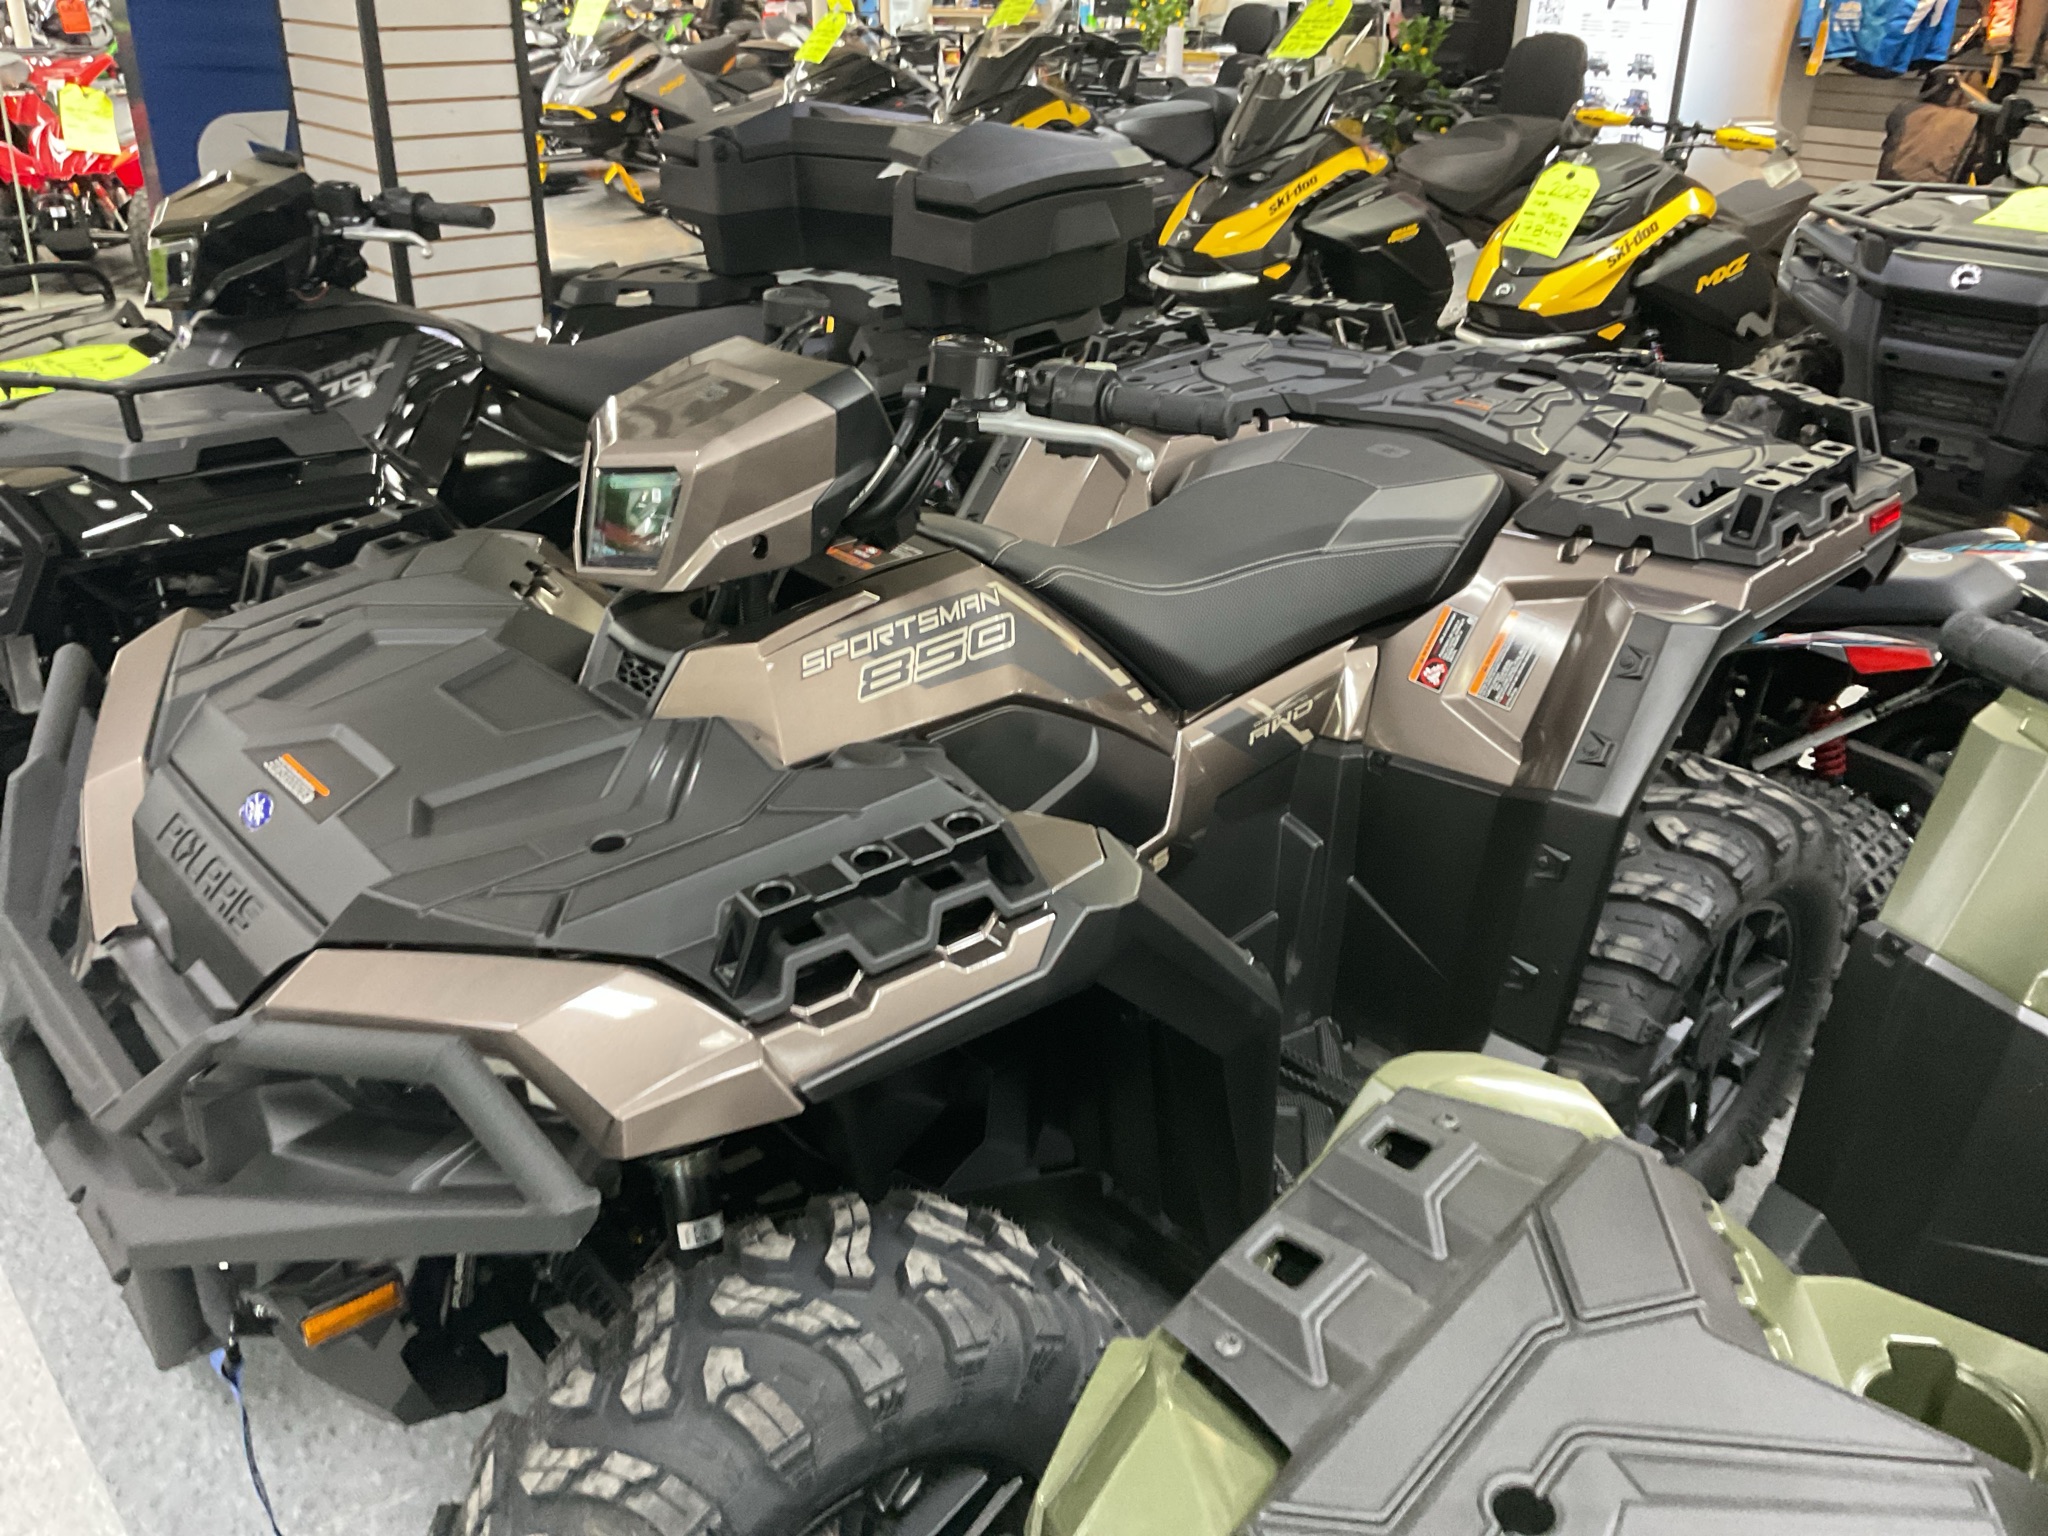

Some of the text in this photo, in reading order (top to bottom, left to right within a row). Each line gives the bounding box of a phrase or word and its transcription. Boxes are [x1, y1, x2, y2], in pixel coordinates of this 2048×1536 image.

[1268, 174, 1318, 217] ski-doo
[1606, 221, 1660, 269] ski-doo
[1695, 252, 1751, 294] MXZ
[801, 587, 1001, 680] SPORTSMAN
[857, 611, 1016, 704] 850
[156, 811, 266, 932] POLARIS
